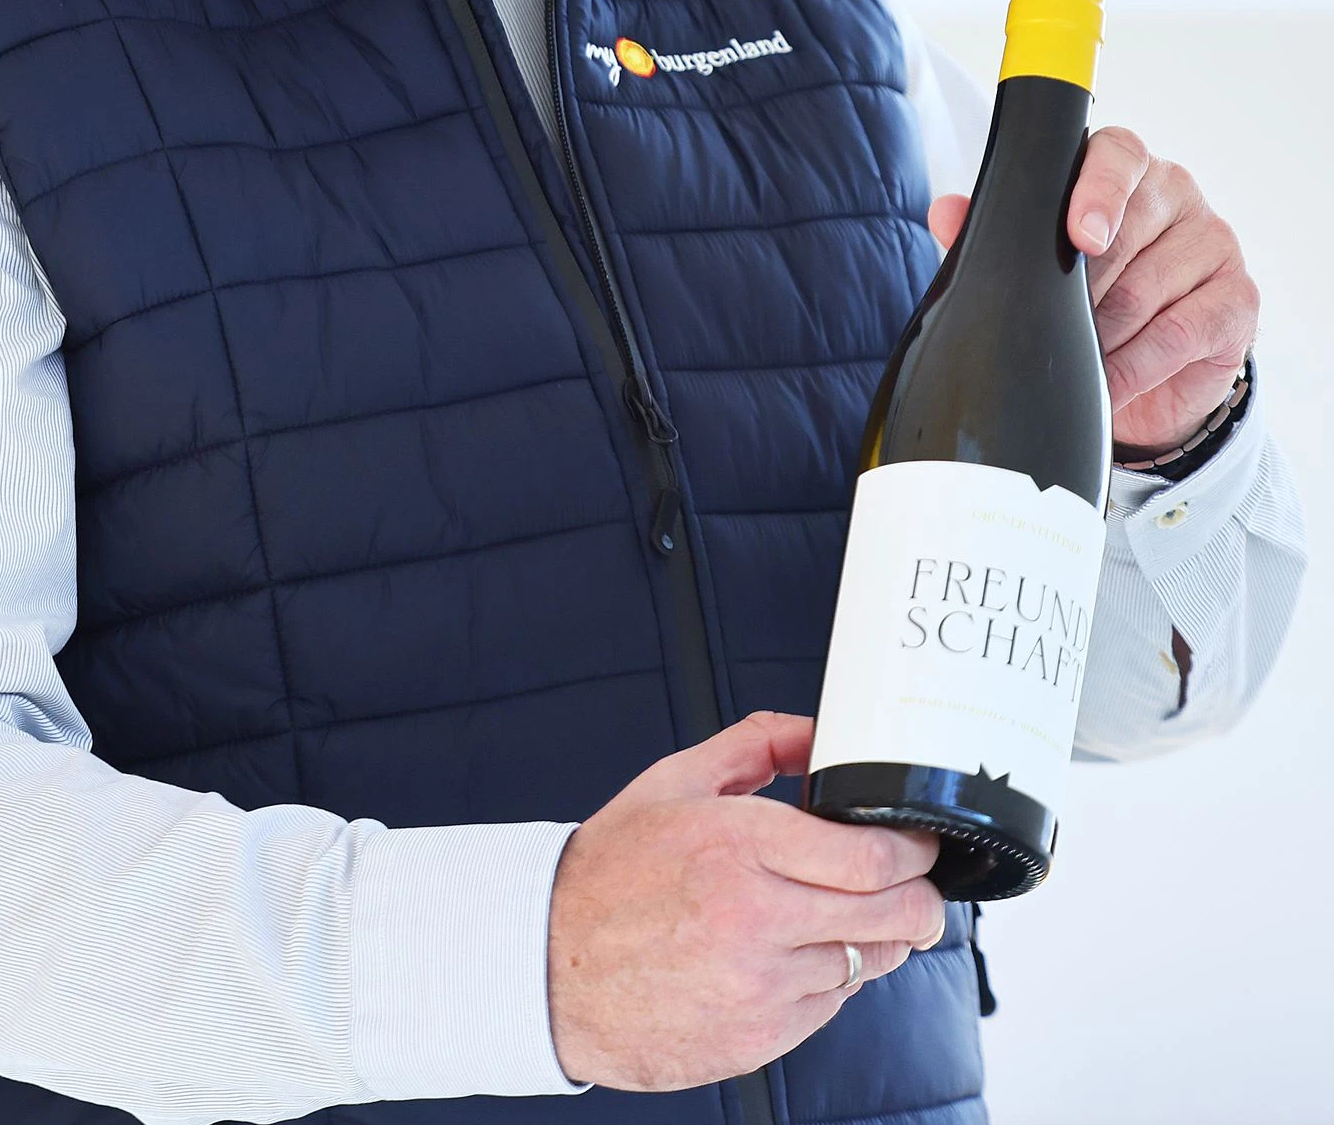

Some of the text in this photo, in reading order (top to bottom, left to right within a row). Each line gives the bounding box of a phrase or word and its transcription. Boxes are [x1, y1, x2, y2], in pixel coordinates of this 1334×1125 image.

[585, 29, 793, 87] my burgenland
[909, 558, 1089, 652] FREUND
[900, 605, 1082, 703] SCHAFT
